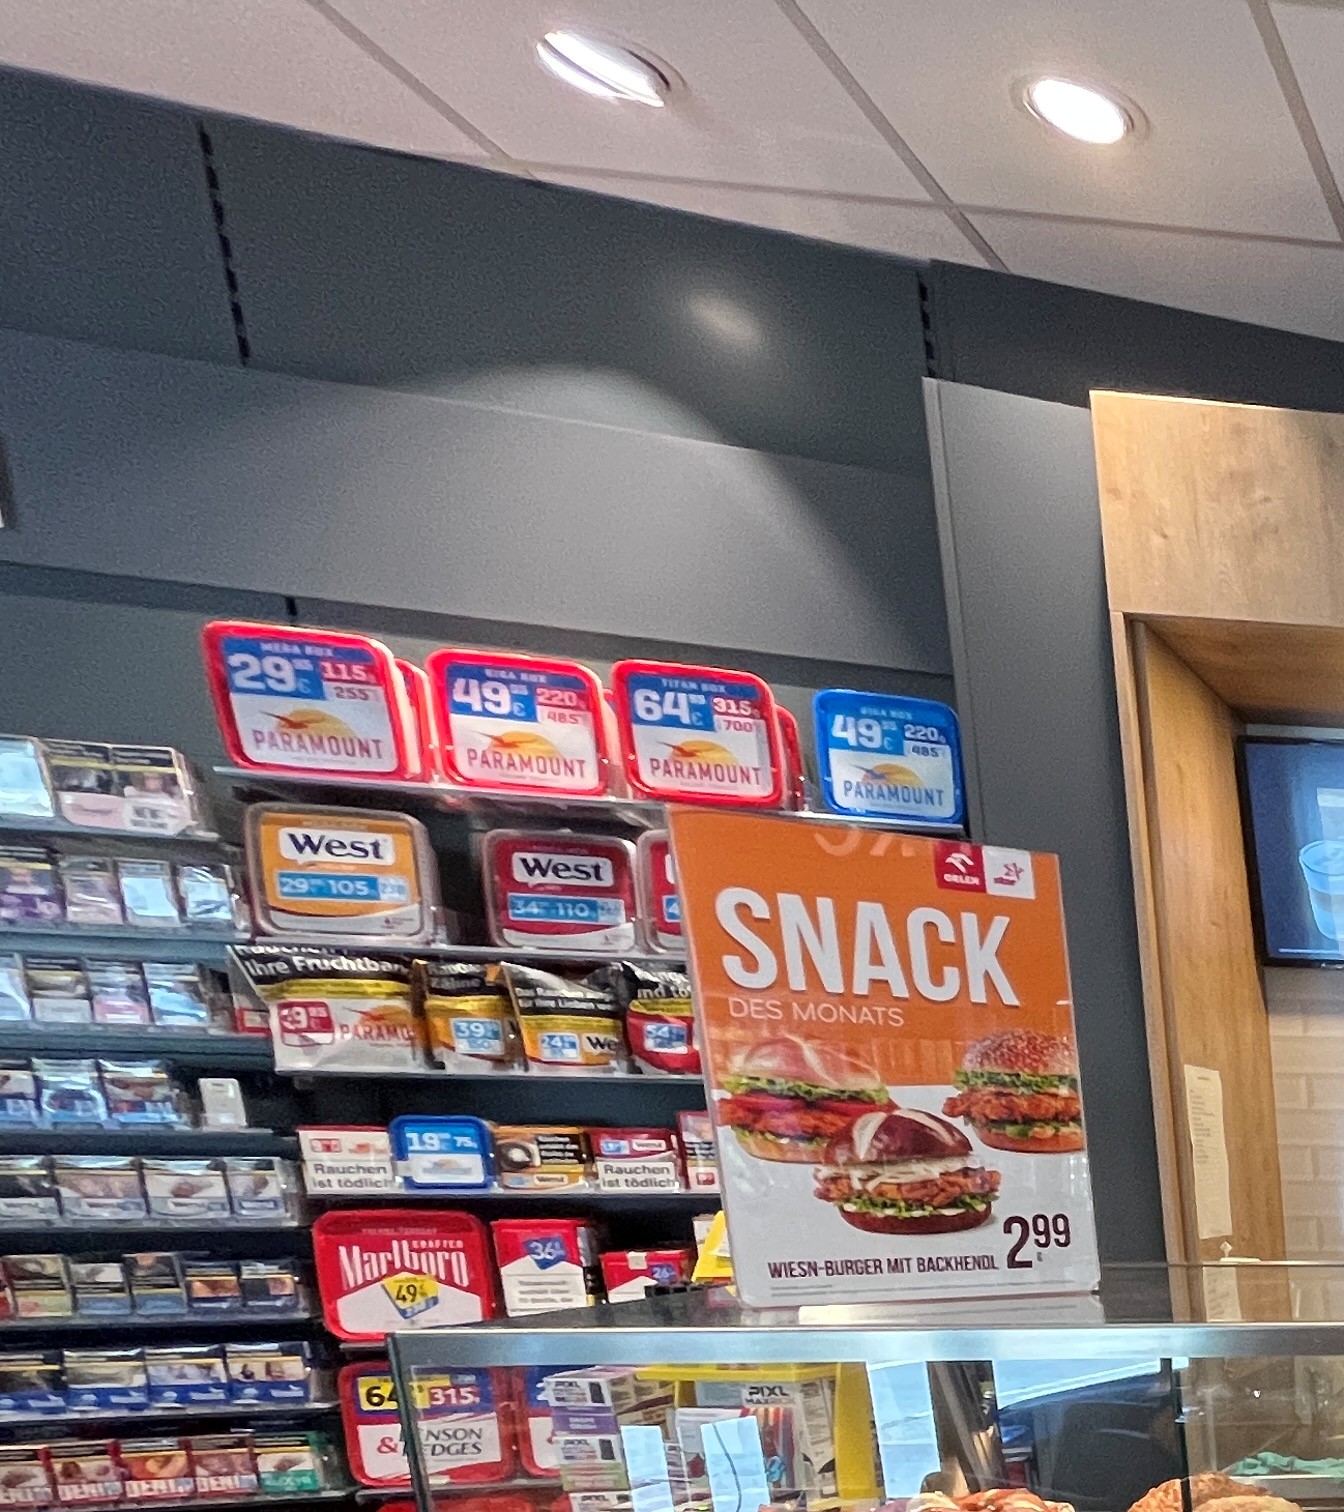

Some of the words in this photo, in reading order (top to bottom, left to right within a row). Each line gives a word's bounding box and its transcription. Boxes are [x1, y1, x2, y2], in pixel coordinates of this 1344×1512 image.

[251, 728, 384, 760] PARAMOUNT
[466, 748, 586, 779] PARAMOUNT
[649, 757, 763, 786] PARAMOUNT
[843, 779, 946, 807] PARAMOUNT
[287, 832, 385, 860] West
[519, 856, 606, 882] West
[714, 885, 1022, 1008] SNACK
[248, 957, 289, 976] Ihre
[727, 996, 784, 1022] DES
[792, 1002, 906, 1028] MONATS
[313, 1162, 388, 1176] Rauchen
[602, 1176, 620, 1188] ist
[604, 1164, 671, 1176] Rauchen
[338, 1239, 470, 1292] Marlboro
[767, 1257, 883, 1280] WIESN-BURGER
[887, 1256, 913, 1275] MIT
[916, 1253, 1000, 1273] BACKHENDL
[747, 1385, 790, 1398] PIXL
[376, 1435, 399, 1455] &
